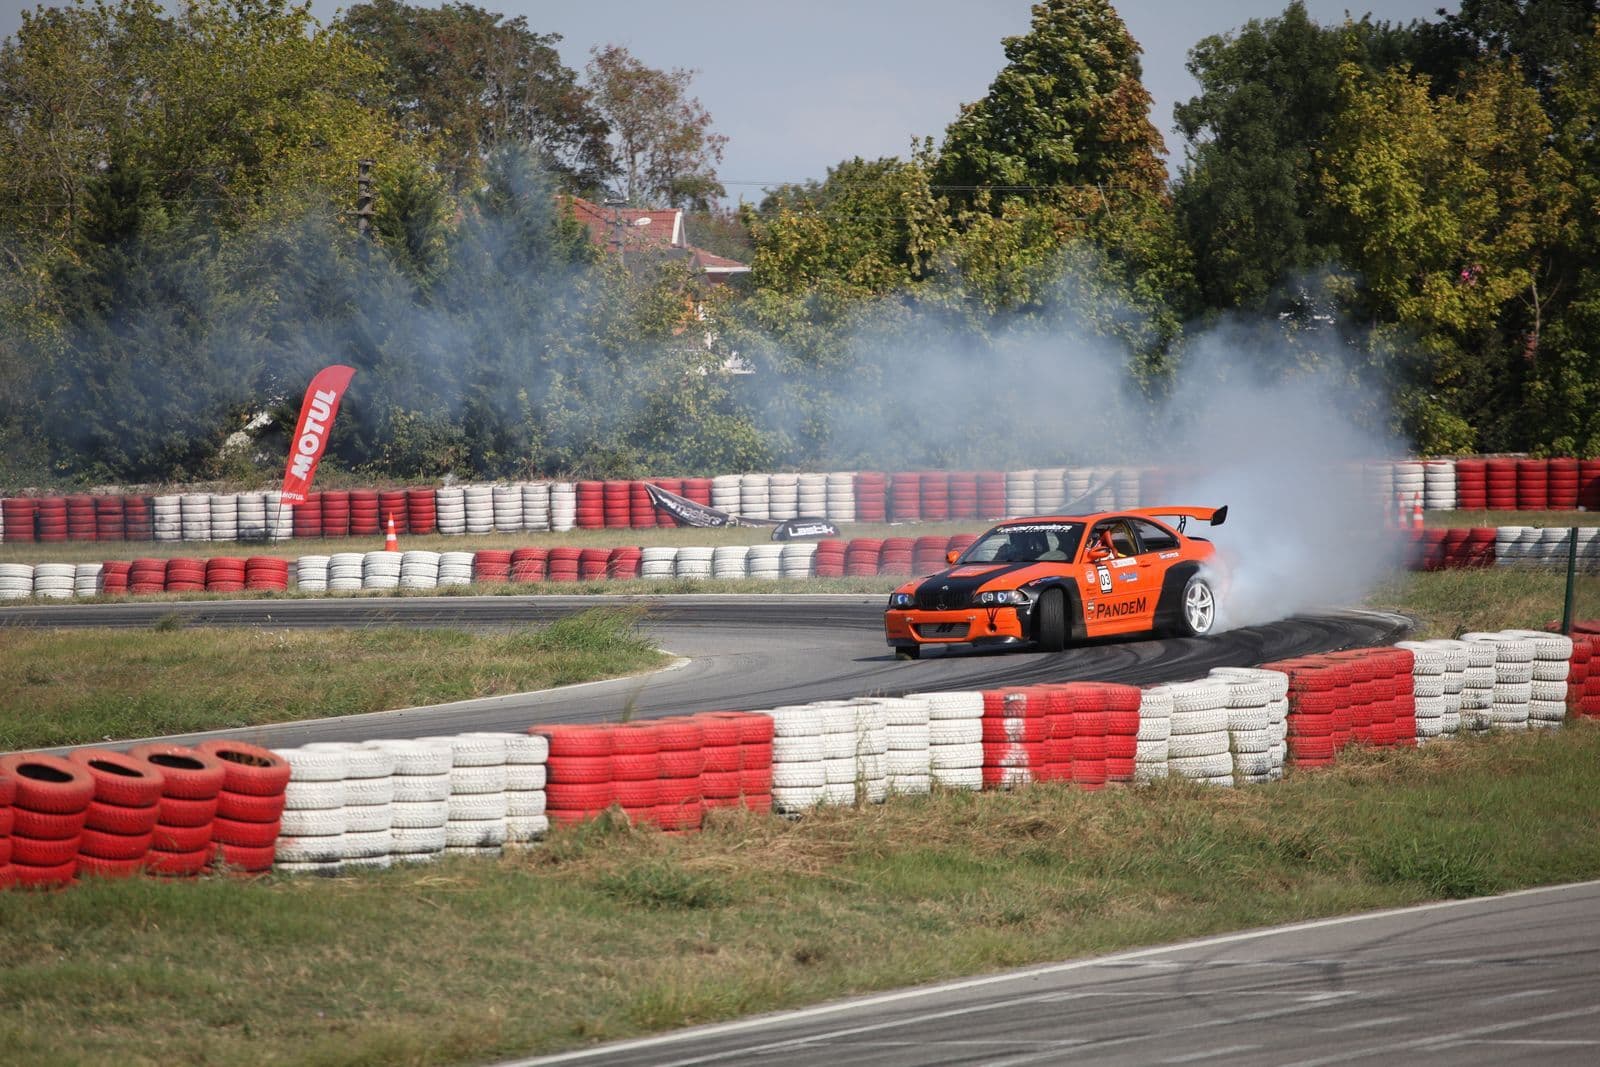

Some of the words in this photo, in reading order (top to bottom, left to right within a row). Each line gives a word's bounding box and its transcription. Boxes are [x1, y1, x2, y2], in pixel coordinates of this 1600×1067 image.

[291, 389, 336, 481] MOTUL
[282, 492, 305, 501] MOTUL
[1100, 574, 1111, 586] 03
[1096, 596, 1147, 620] PANDEM
